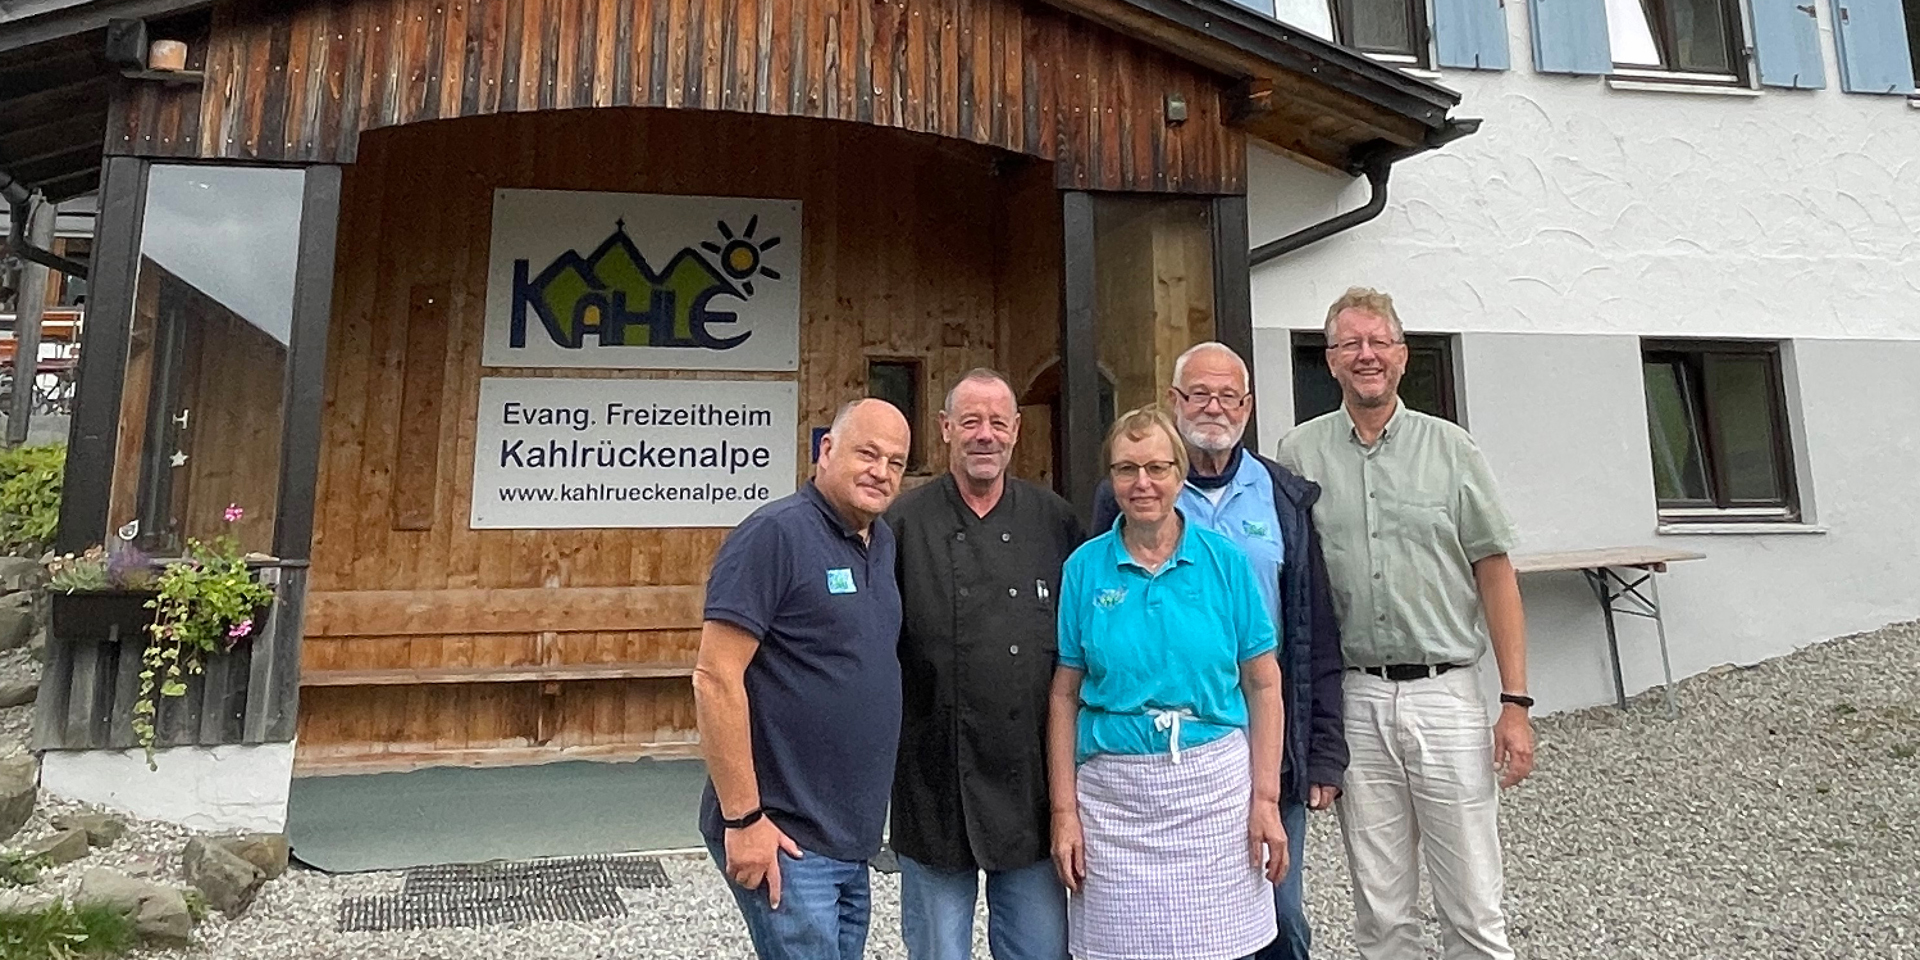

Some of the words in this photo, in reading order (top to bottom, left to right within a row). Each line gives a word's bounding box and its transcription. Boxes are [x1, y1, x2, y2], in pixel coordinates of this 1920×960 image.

[509, 249, 752, 350] KAHLE
[503, 402, 597, 431] Evang.
[606, 403, 772, 427] Freizeitheim
[500, 439, 770, 474] Kahlrückenalpe
[499, 482, 769, 504] www.kahlrueckenalpe.de
